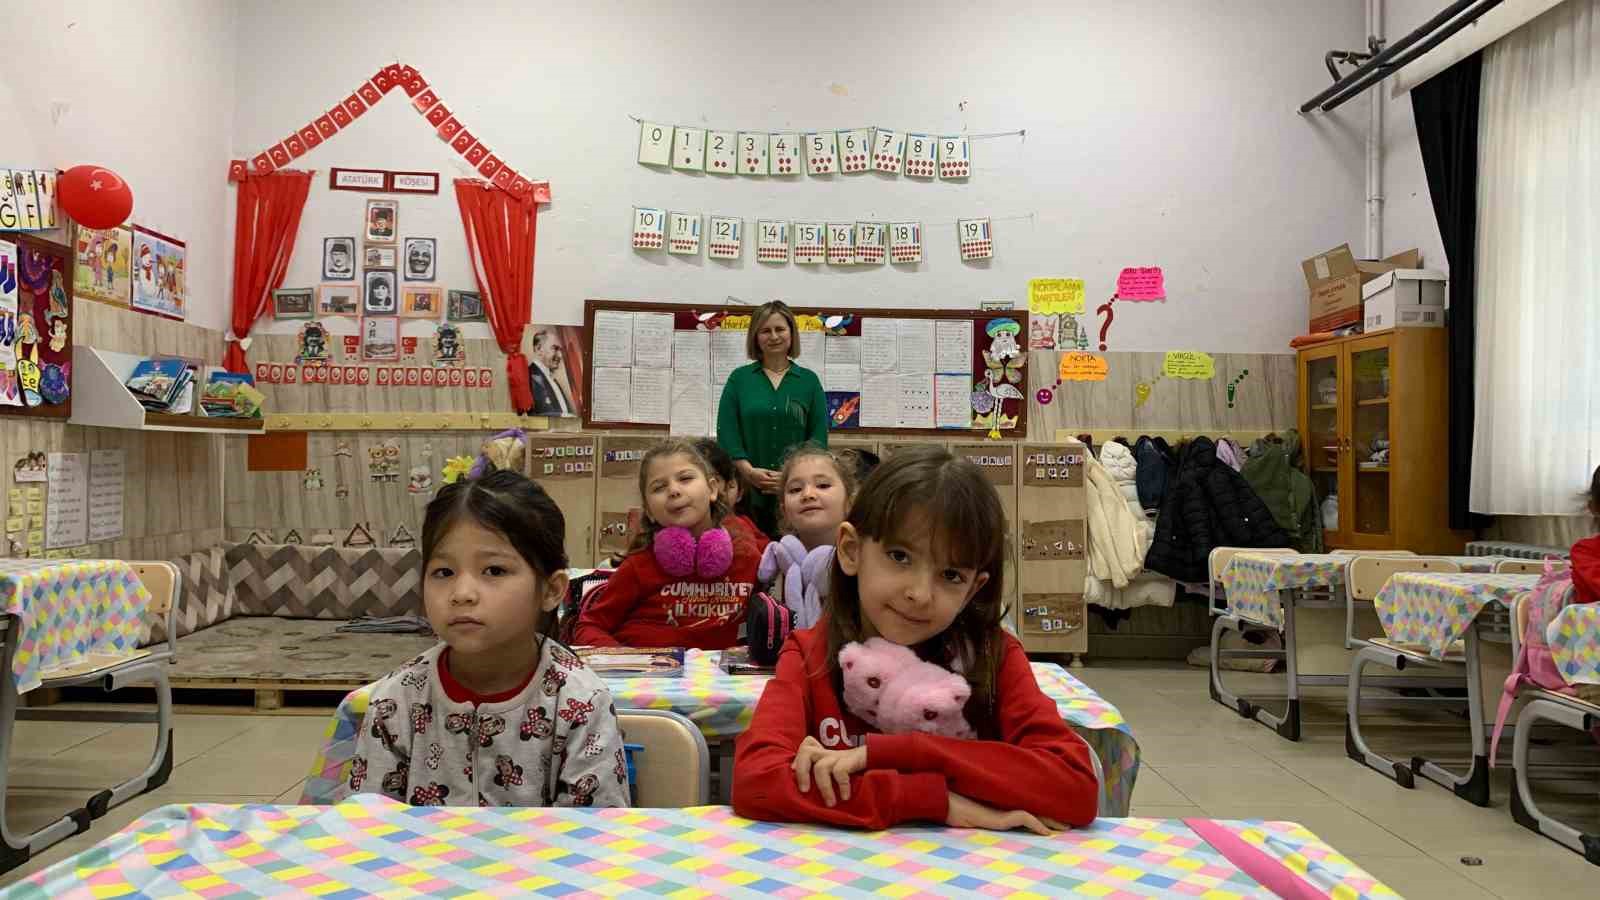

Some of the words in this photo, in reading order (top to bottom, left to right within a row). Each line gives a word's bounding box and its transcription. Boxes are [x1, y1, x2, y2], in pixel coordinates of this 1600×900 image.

[651, 128, 662, 142] 0
[883, 135, 893, 148] 7
[714, 136, 724, 150] 2
[746, 138, 754, 151] 3
[776, 138, 786, 151] 4
[814, 138, 823, 151] 5
[846, 136, 855, 149] 6
[913, 140, 922, 153] 8
[946, 142, 955, 154] 9
[27, 204, 34, 228] F
[640, 213, 654, 226] 10
[678, 217, 688, 232] 11
[716, 222, 730, 236] 12
[965, 223, 978, 238] 19
[763, 225, 777, 240] 14
[800, 227, 815, 241] 15
[832, 228, 846, 242] 16
[862, 226, 876, 241] 17
[895, 226, 909, 241] 18
[660, 581, 754, 598] CUMHURİYET
